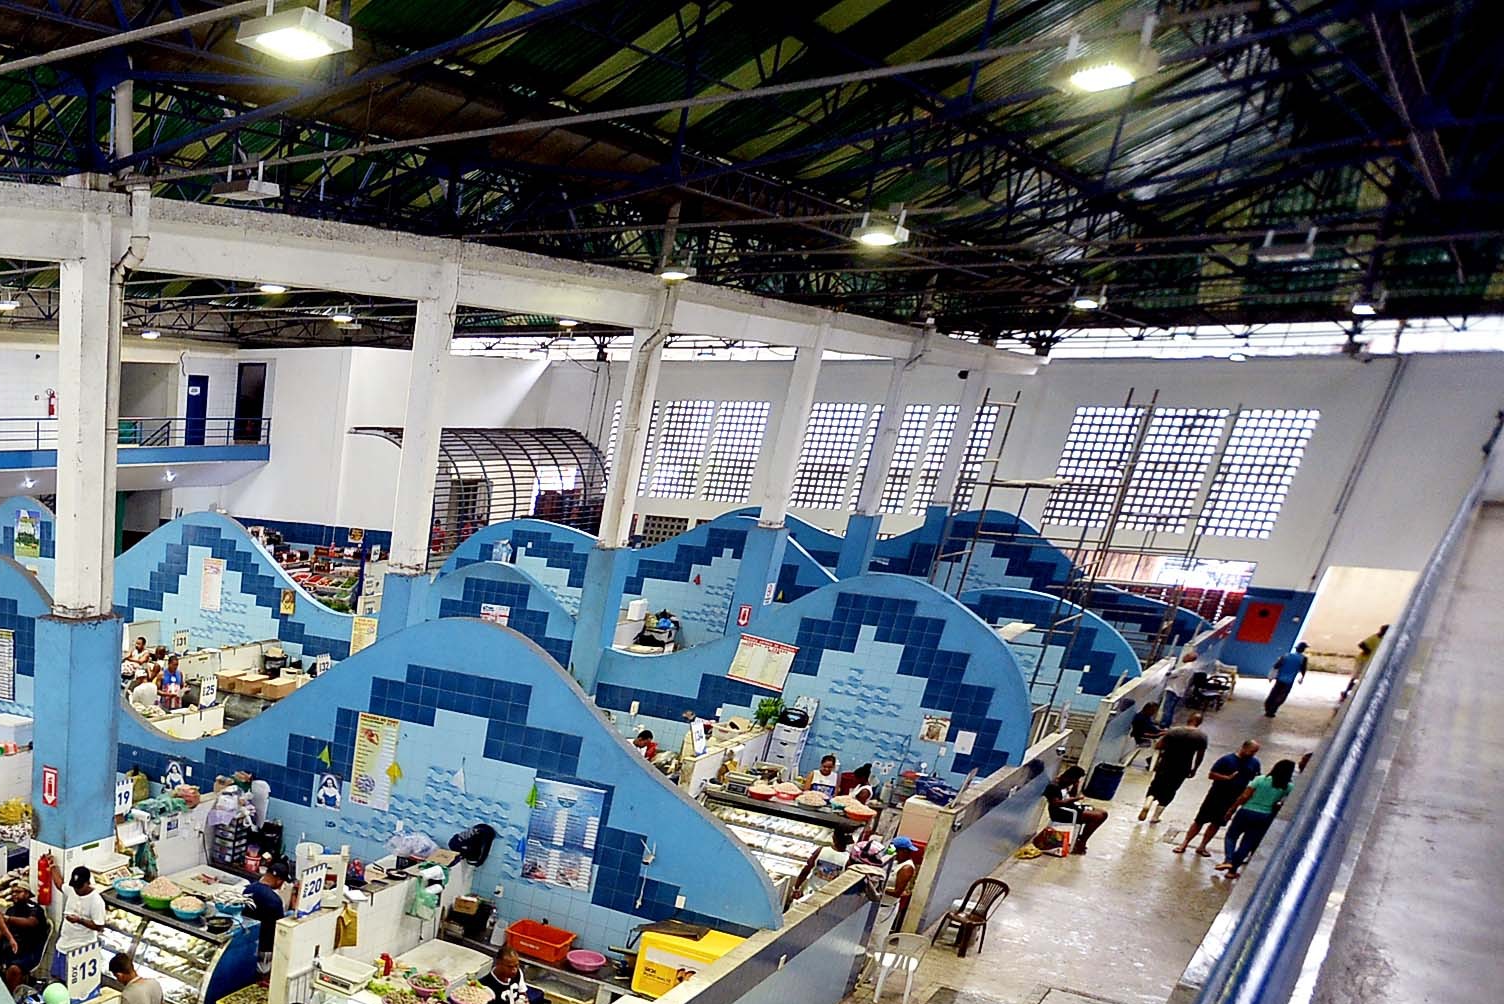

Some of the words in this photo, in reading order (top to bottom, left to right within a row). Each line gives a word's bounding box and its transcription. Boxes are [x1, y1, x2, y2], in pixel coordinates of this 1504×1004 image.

[206, 684, 215, 696] 25
[117, 790, 130, 806] 19
[308, 877, 322, 896] 20
[79, 958, 97, 980] 13
